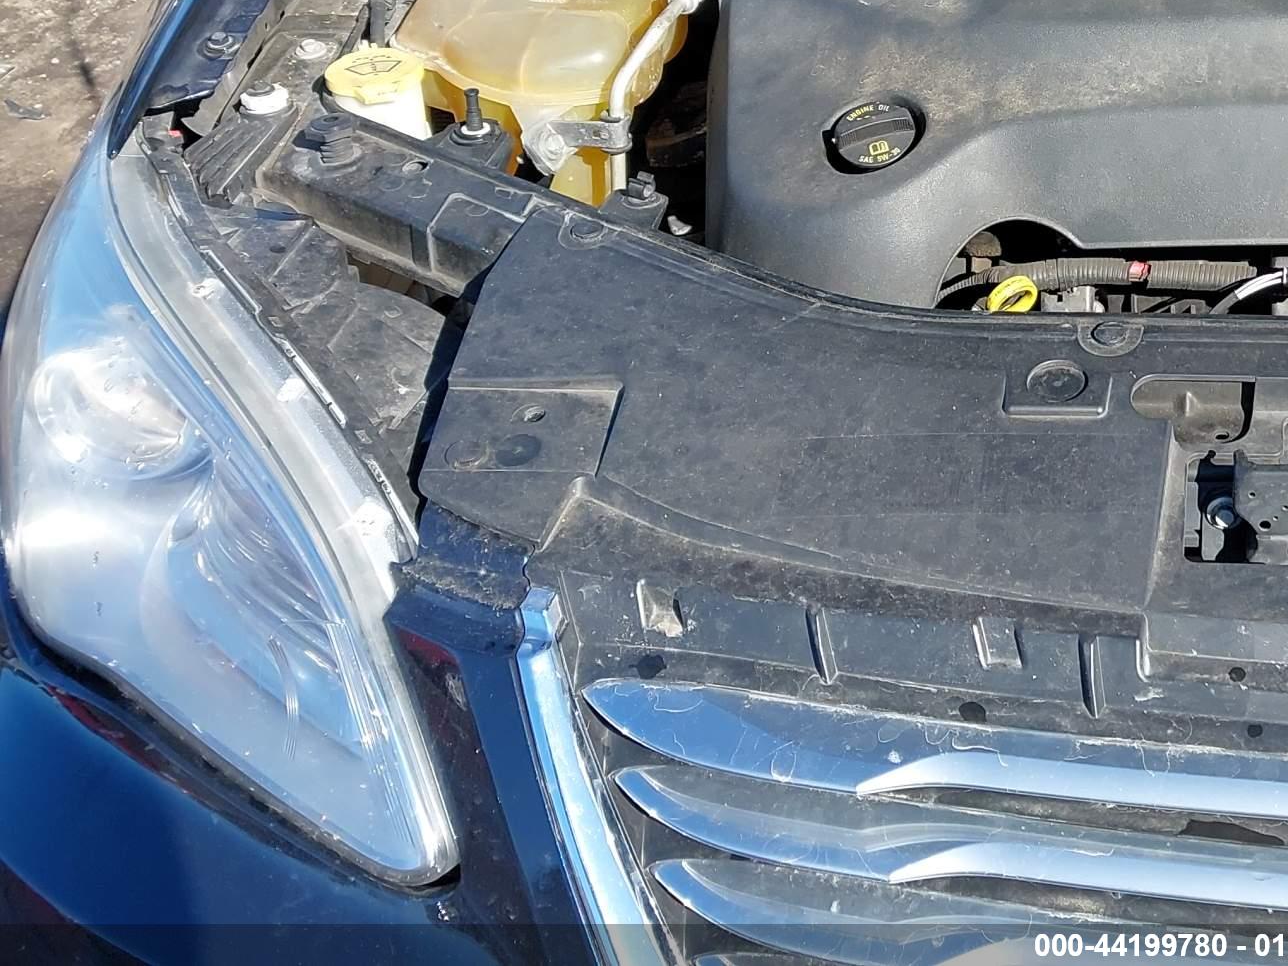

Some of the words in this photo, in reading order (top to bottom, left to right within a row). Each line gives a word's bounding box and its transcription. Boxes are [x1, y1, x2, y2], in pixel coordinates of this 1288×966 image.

[846, 104, 875, 122] ENGINE
[878, 104, 890, 112] OIL
[858, 155, 874, 164] SAE
